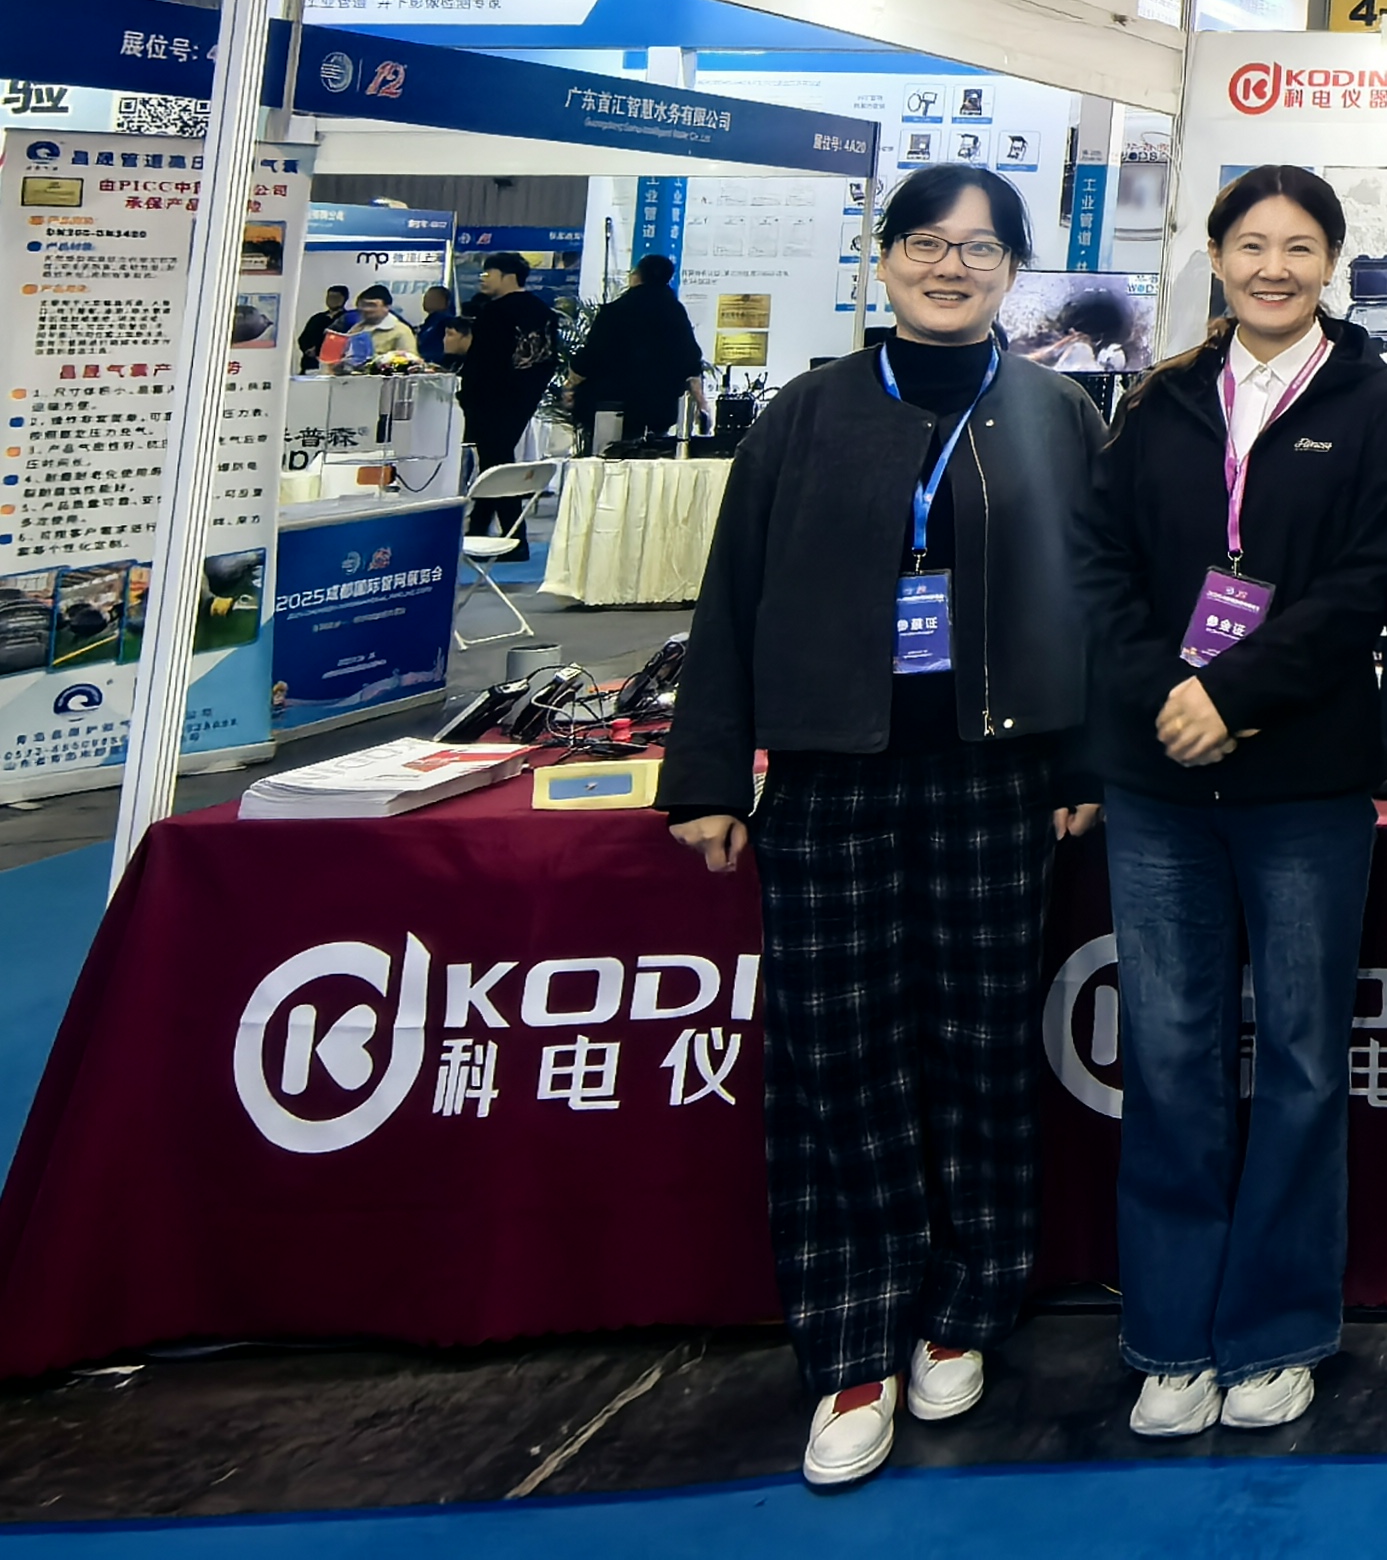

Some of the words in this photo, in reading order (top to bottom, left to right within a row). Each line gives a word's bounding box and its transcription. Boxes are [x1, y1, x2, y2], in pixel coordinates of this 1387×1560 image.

[444, 953, 761, 1029] KODI
[432, 1025, 743, 1119] 科电仪
